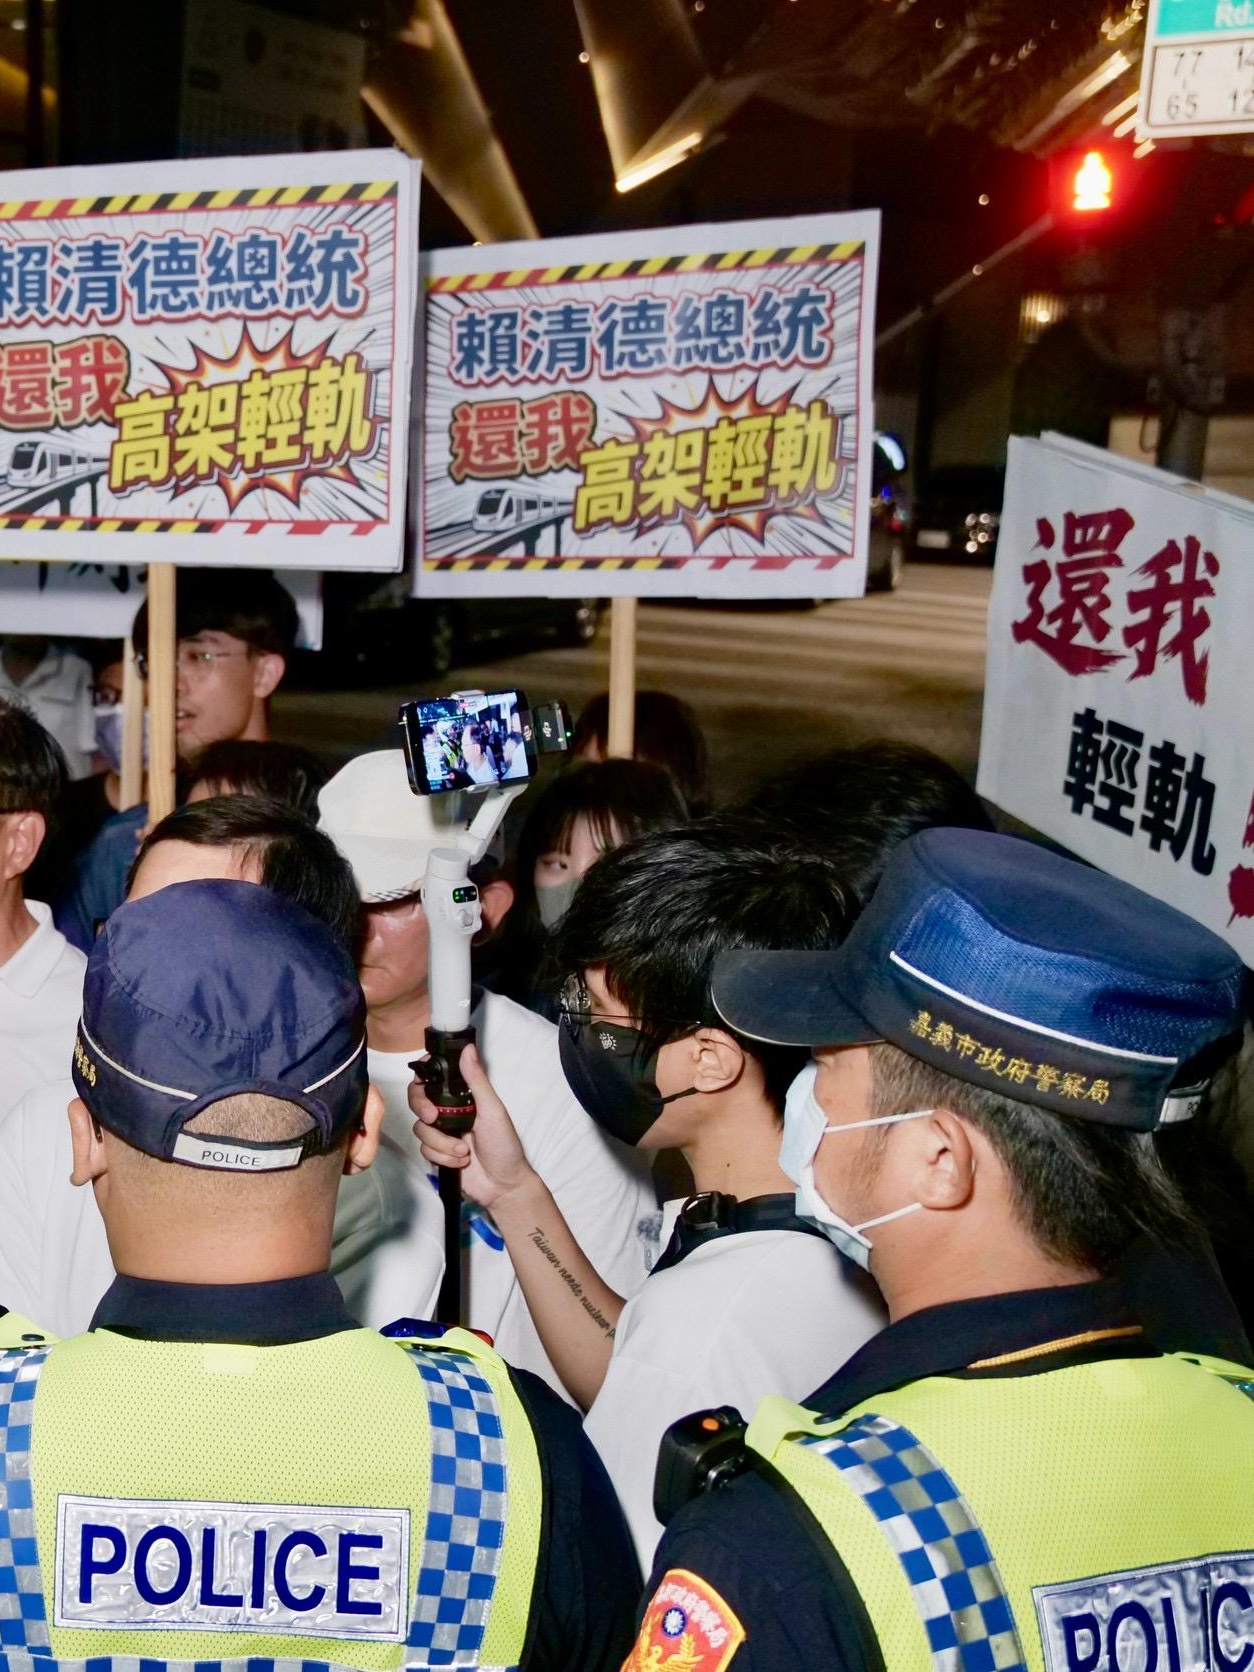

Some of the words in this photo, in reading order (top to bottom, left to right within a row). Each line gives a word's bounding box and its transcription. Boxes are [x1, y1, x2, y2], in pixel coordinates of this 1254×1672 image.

[1166, 94, 1198, 120] 65
[1173, 51, 1202, 76] 77
[452, 287, 828, 379] 賴清德總統
[111, 354, 372, 490] 高架輕軌
[452, 394, 597, 479] 還我
[575, 400, 838, 528] 高架輕軌
[1011, 507, 1221, 707] 還我
[1062, 707, 1217, 877] 輕軌
[908, 1008, 1112, 1106] 嘉義市政府警察局
[201, 1149, 262, 1167] POLICE
[527, 1226, 562, 1269] Taiwan
[558, 1267, 584, 1298] needs
[78, 1523, 384, 1616] POLICE
